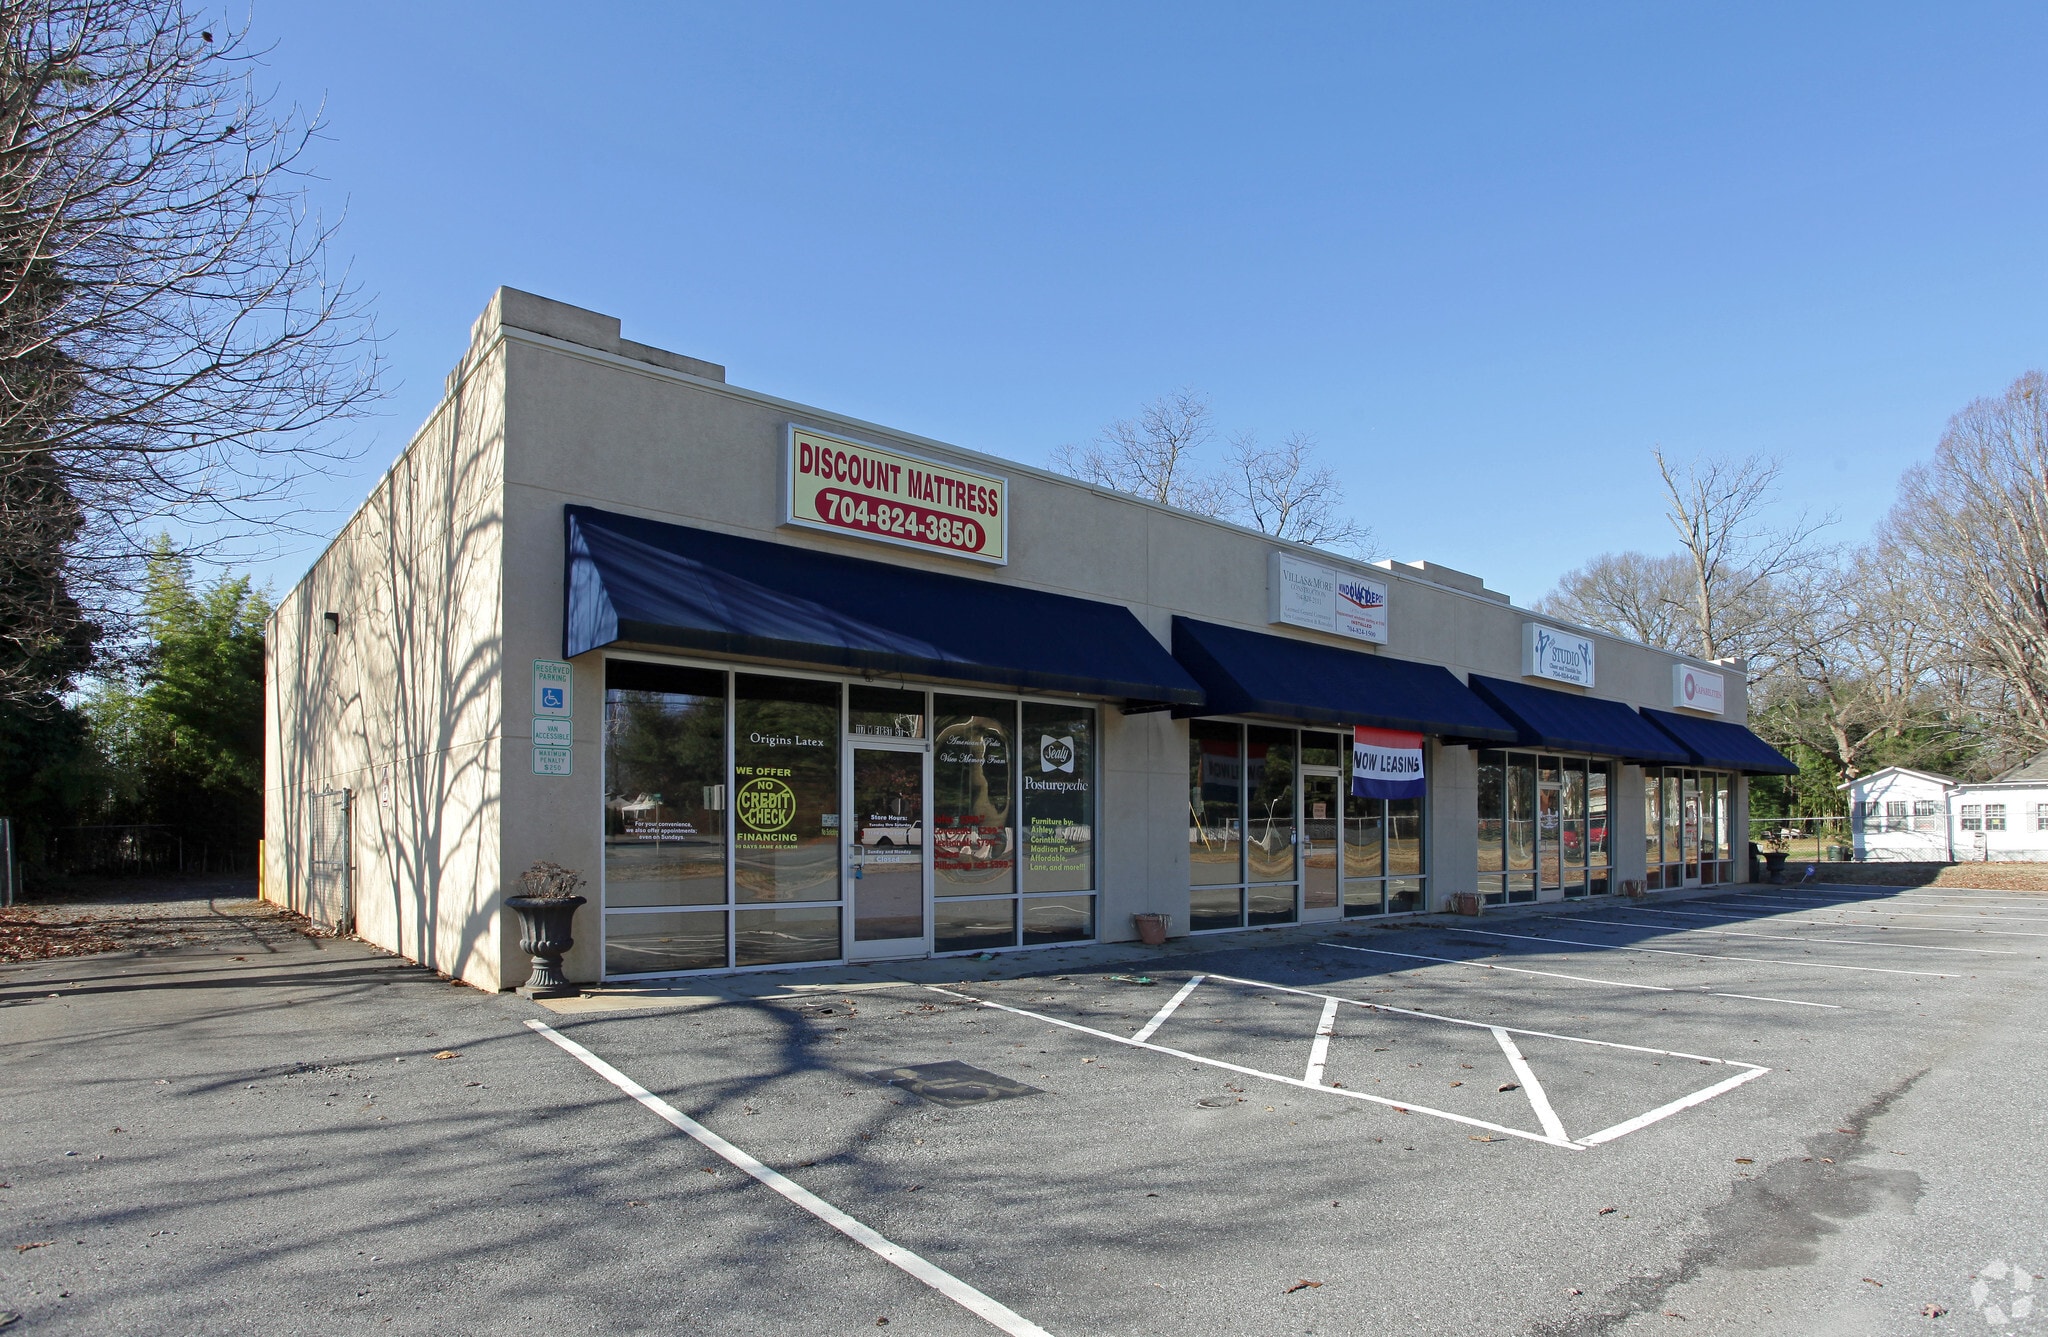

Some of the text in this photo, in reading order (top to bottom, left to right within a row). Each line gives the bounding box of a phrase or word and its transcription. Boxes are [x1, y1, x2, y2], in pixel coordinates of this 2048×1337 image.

[799, 442, 998, 517] DISCOUNT MATTRESS
[825, 492, 977, 549] 704-824-3850
[1552, 646, 1579, 667] STUDIO
[536, 664, 570, 675] RESERVED
[539, 673, 566, 682] PARKING
[536, 732, 569, 741] ACCESSIBLE
[874, 726, 892, 736] FIRST
[750, 732, 824, 748] Origins Latex
[959, 753, 985, 765] Memory
[987, 754, 1005, 764] Foam
[1045, 745, 1069, 763] Sealy
[1354, 751, 1420, 773] NOW LEASING
[736, 766, 791, 777] WE OFFER
[757, 781, 774, 790] NO
[1025, 775, 1089, 794] Posturepedic
[741, 791, 790, 809] CREDIT
[748, 808, 787, 825] CHECK
[1031, 817, 1073, 826] Furniture by:
[1031, 825, 1054, 834] Ashley,
[737, 833, 798, 842] FINANCING
[1030, 836, 1067, 844] Corinthian,
[1030, 845, 1077, 853] Madison Park,
